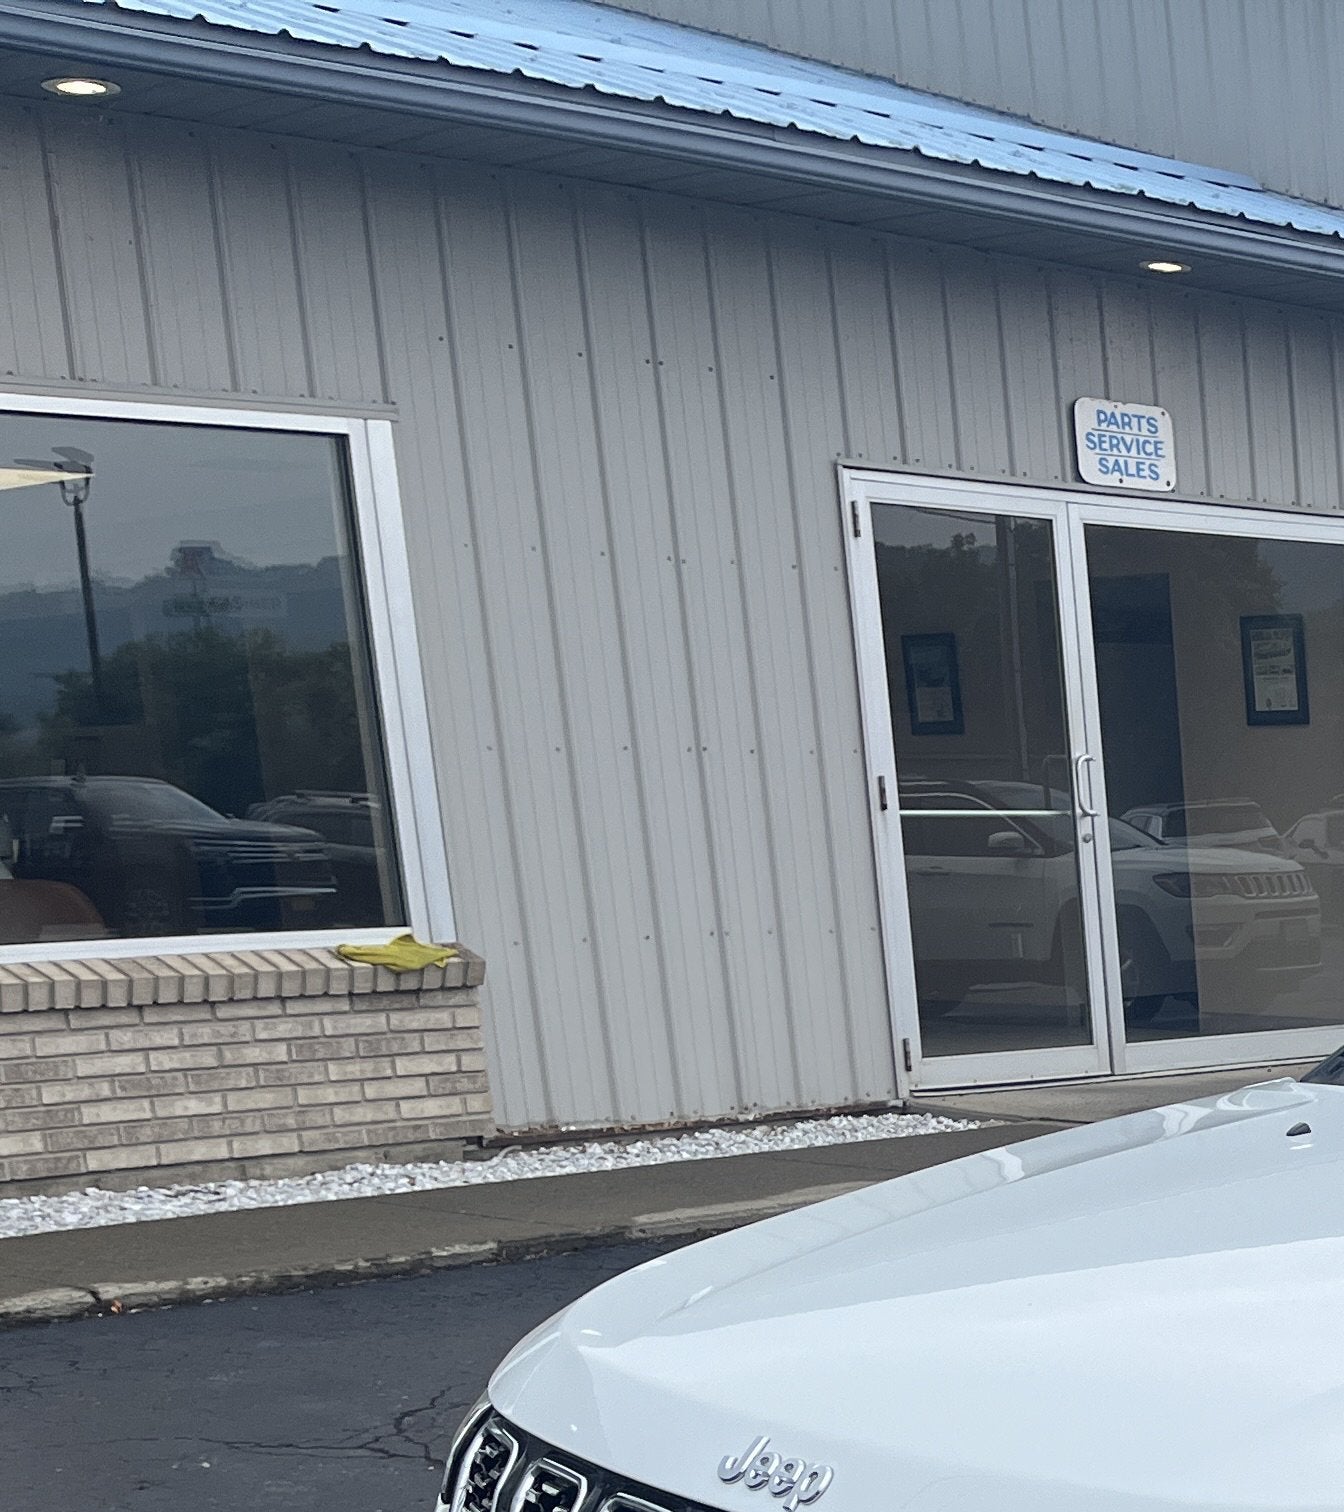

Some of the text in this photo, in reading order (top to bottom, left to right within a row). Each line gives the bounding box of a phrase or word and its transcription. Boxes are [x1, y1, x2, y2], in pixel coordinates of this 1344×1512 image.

[1096, 409, 1159, 435] PARTS
[1085, 431, 1166, 459] SERVICE
[1098, 457, 1160, 481] SALES
[717, 1436, 834, 1512] Jeep
